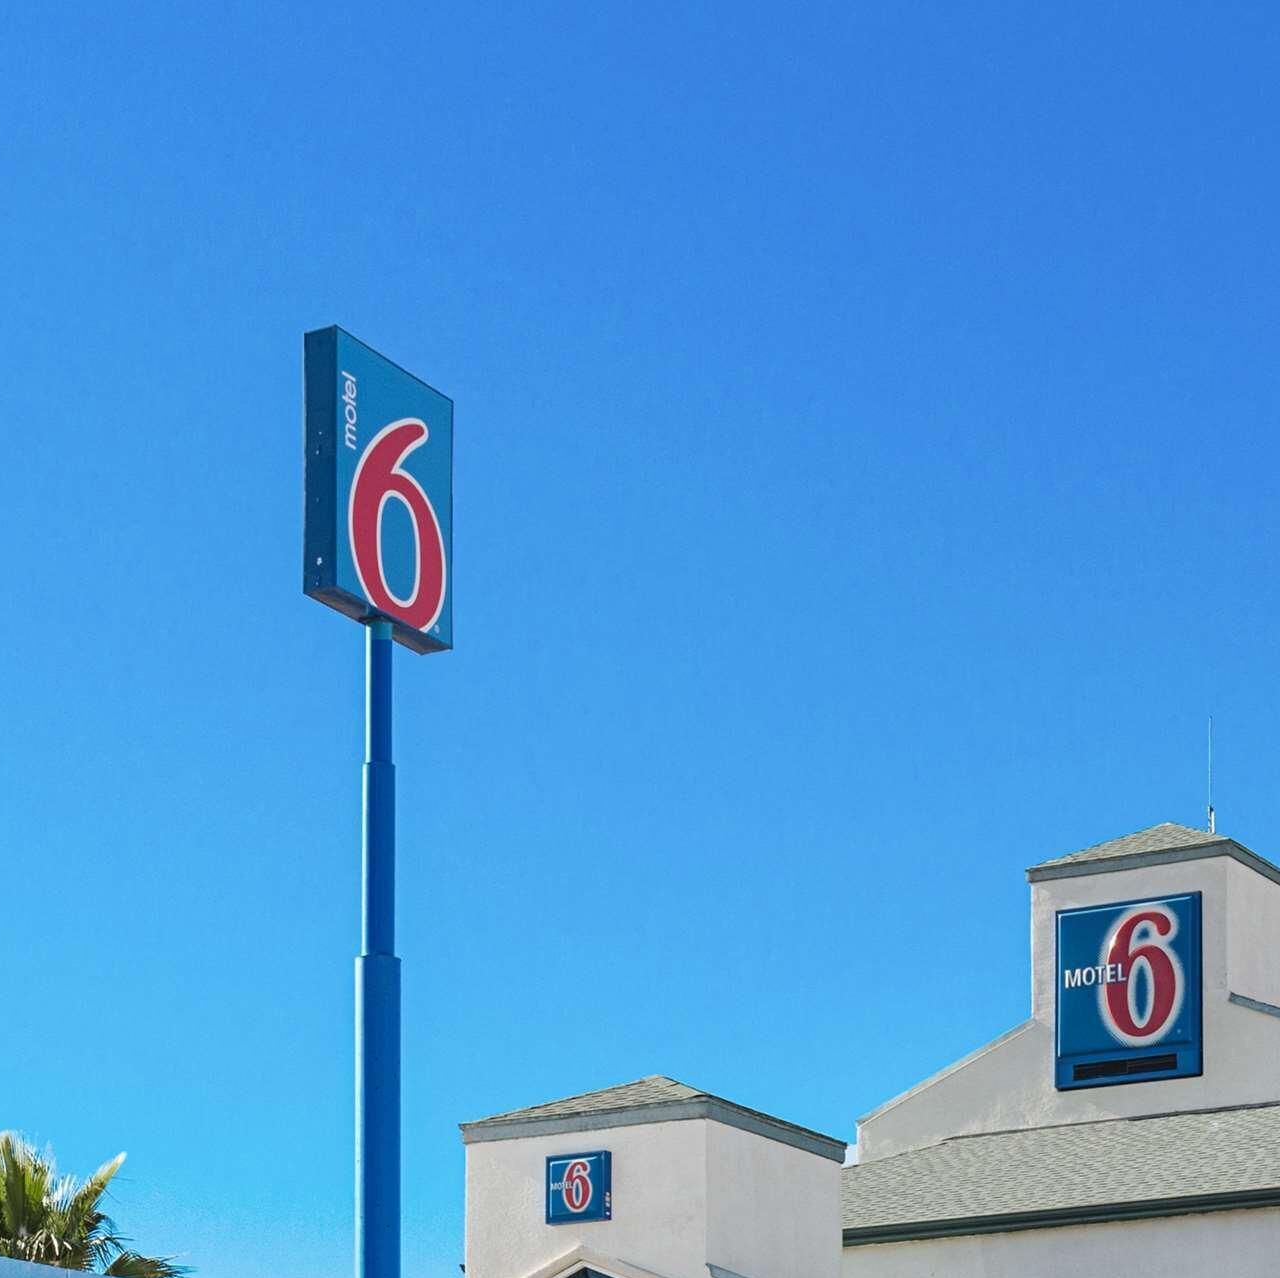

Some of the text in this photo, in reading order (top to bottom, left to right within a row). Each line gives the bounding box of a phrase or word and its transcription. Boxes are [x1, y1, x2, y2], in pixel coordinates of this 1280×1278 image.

[341, 371, 357, 450] motel
[348, 418, 446, 632] 6
[1064, 906, 1182, 1043] MOTEL 6
[551, 1160, 592, 1213] MOTEL 6
